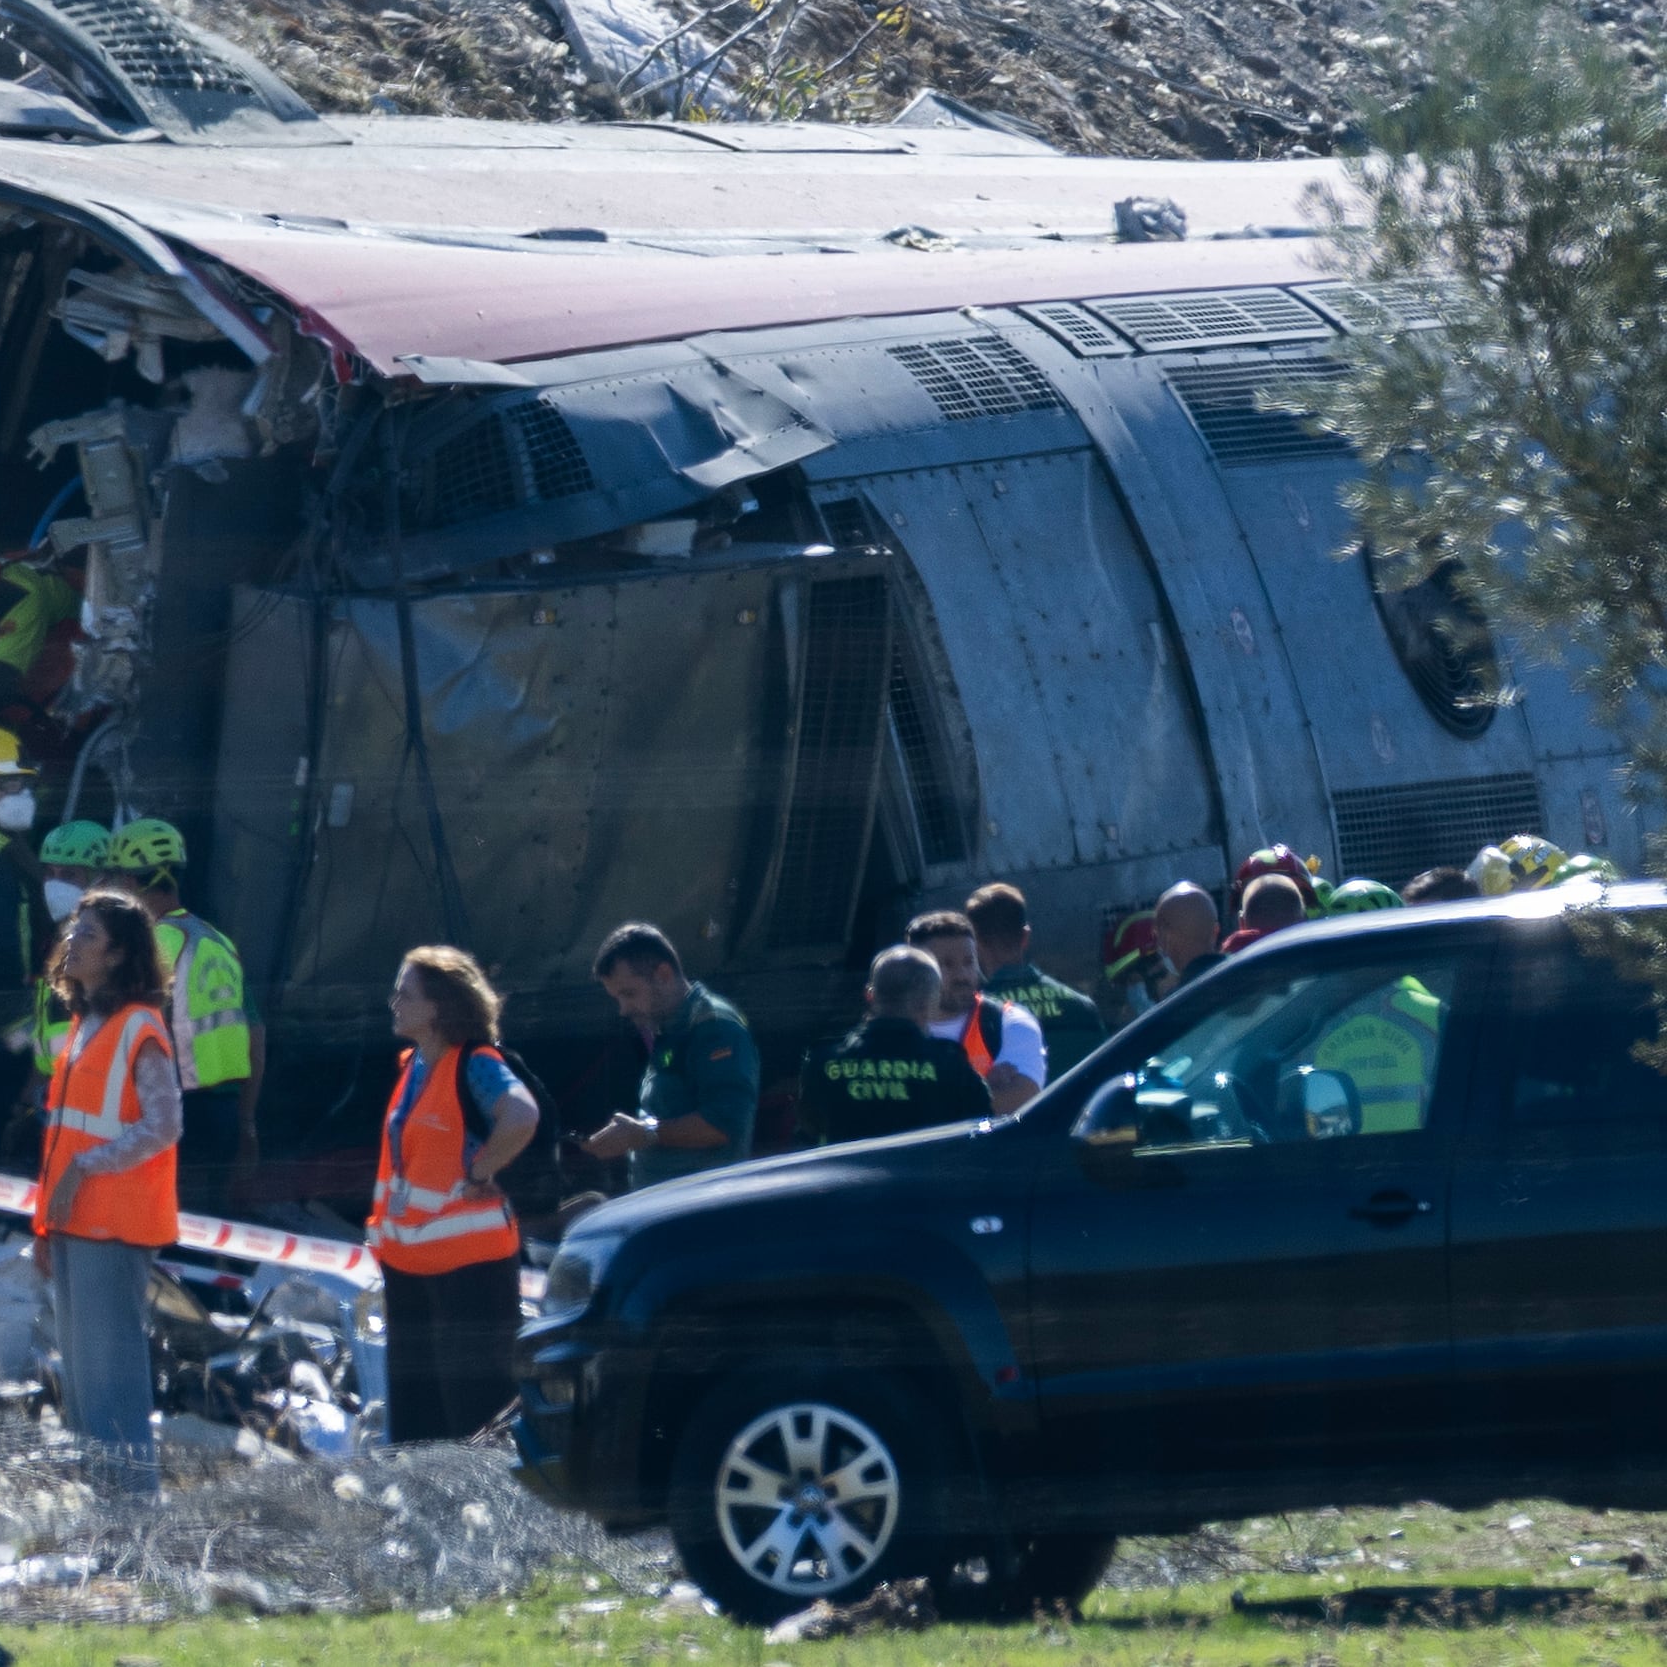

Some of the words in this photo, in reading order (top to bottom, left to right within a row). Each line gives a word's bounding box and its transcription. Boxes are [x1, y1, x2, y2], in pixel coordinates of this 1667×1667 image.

[992, 984, 1074, 1003] UARDI
[824, 1059, 938, 1081] GUARDIA
[847, 1080, 909, 1101] CIVIL
